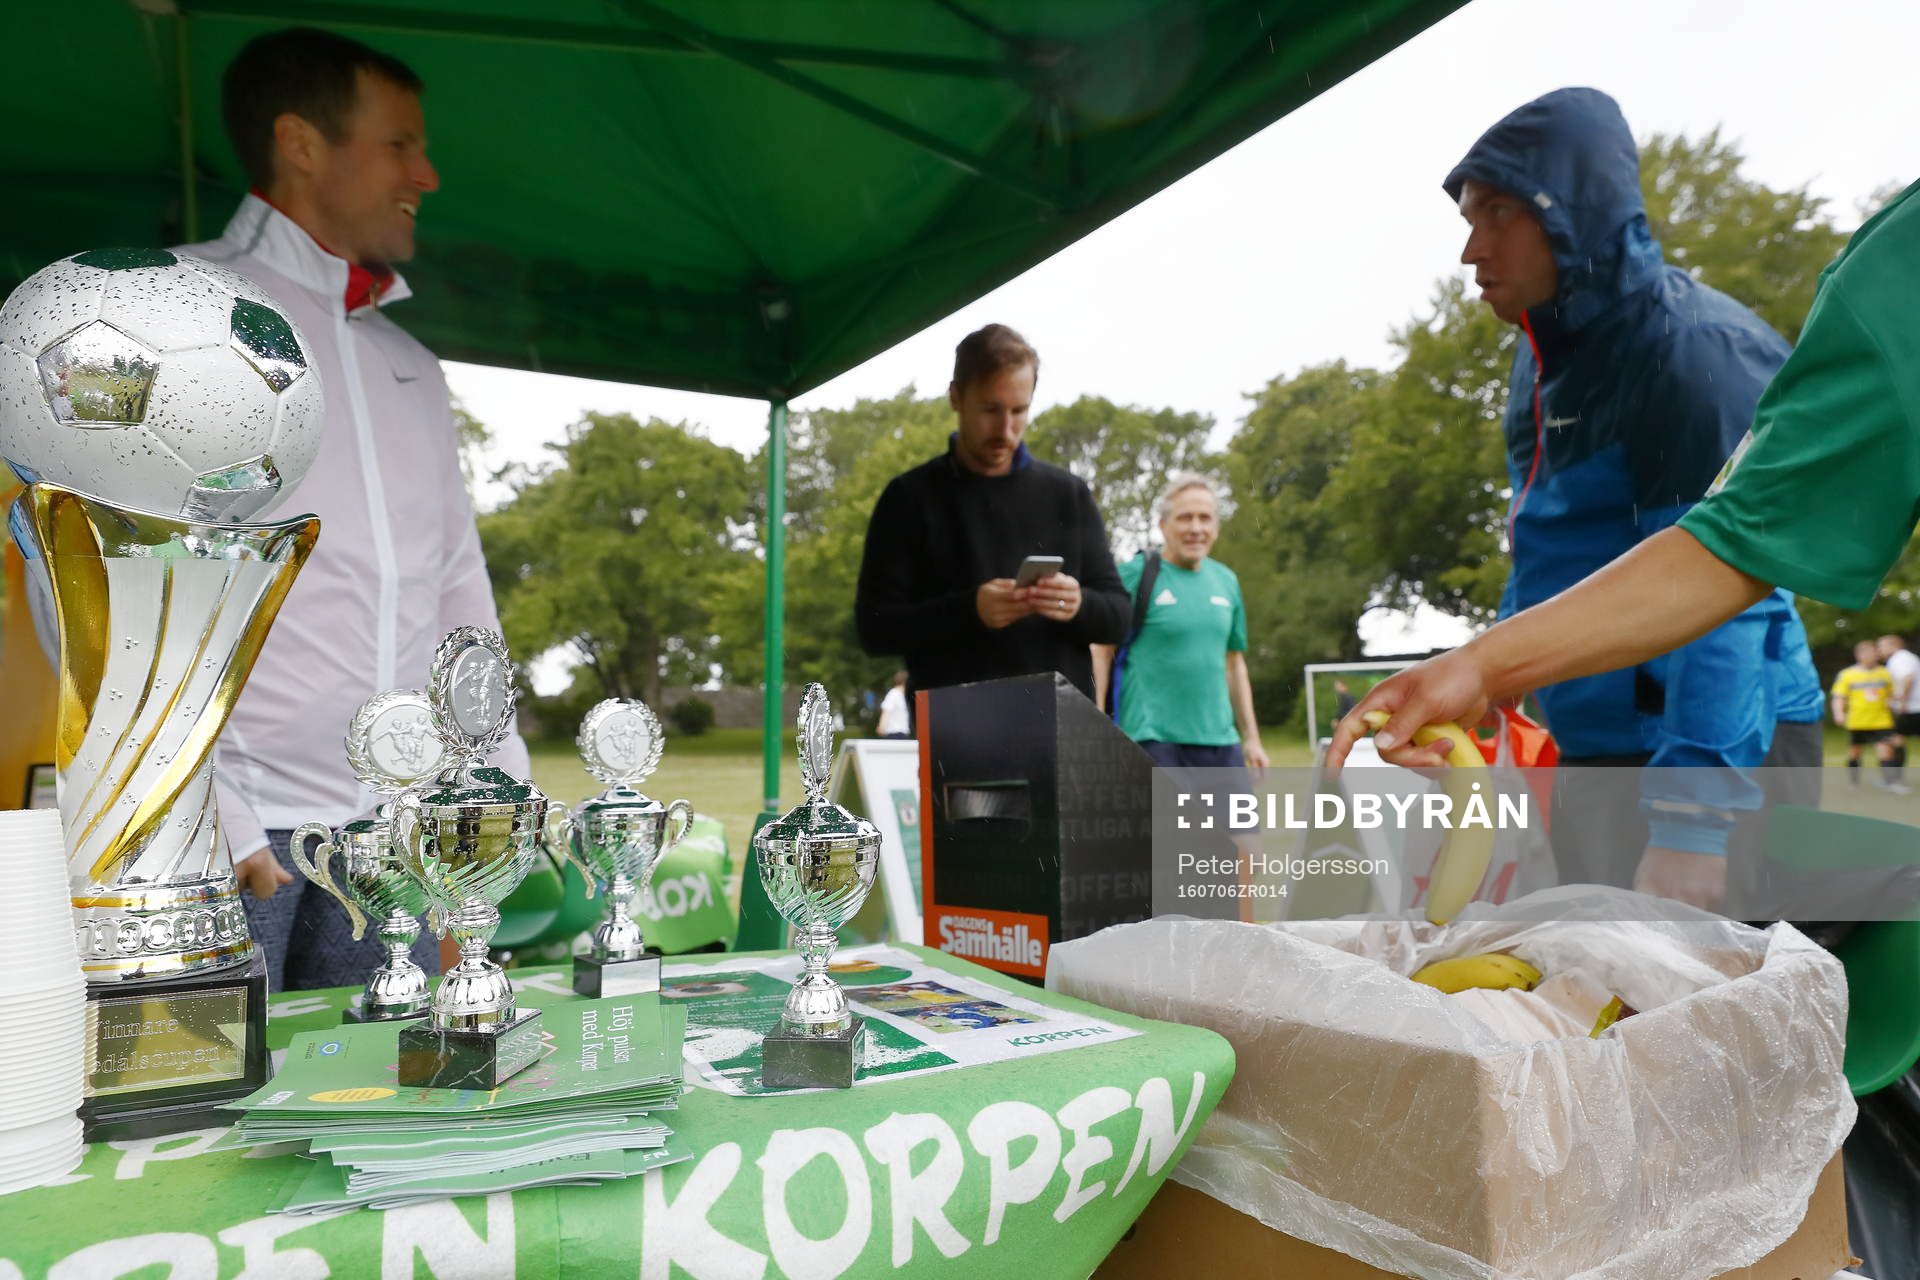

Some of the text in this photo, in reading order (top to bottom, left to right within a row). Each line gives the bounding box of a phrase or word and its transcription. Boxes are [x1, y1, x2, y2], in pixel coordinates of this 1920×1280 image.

[939, 915, 1043, 967] Samhälle
[97, 1017, 180, 1040] innare
[576, 1010, 605, 1072] med Korpen
[608, 1005, 636, 1064] Höj pulsen
[1006, 1026, 1113, 1047] KORPEN
[94, 1045, 221, 1075] edalscupen
[638, 1071, 1206, 1280] KORPEN
